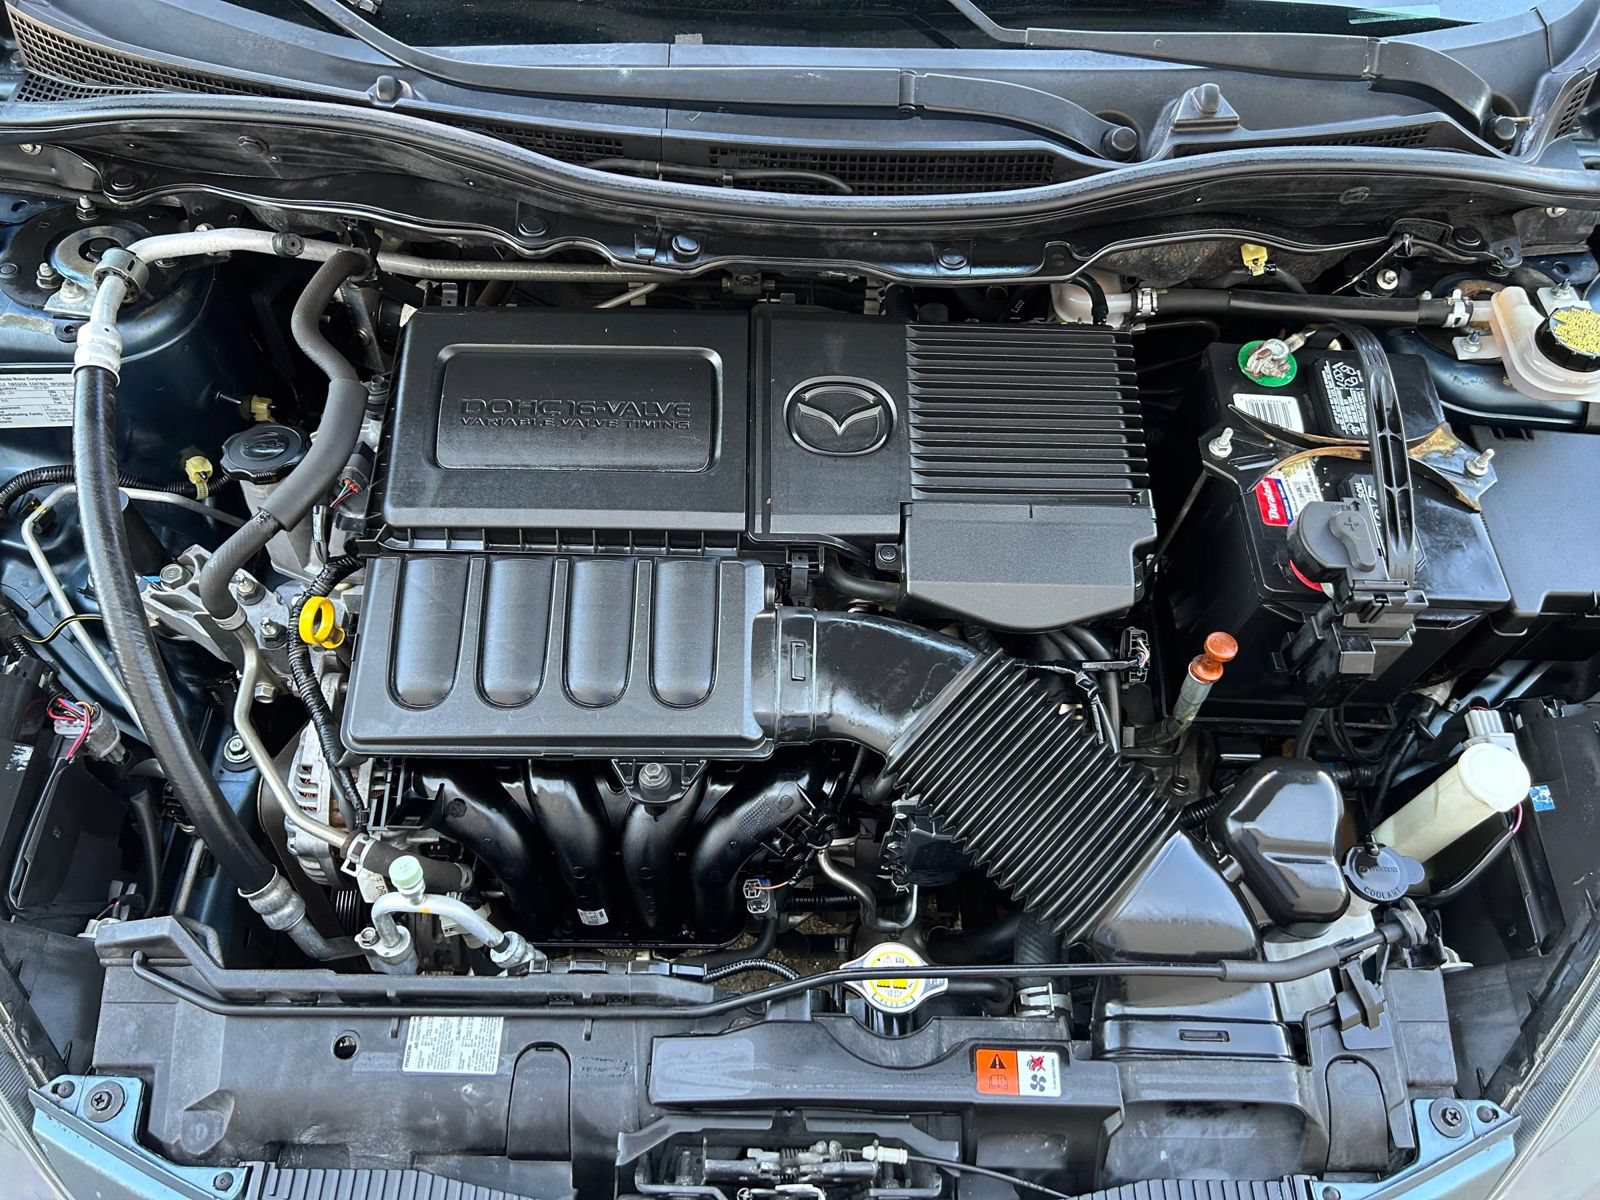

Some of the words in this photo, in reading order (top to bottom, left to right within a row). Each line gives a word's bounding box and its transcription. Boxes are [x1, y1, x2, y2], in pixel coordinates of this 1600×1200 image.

[460, 398, 562, 417] DOHC
[567, 399, 691, 418] 16-VALVE
[459, 416, 555, 428] VARIABLE
[559, 417, 619, 429] VALVE
[622, 419, 690, 430] TIMING
[1261, 478, 1280, 520] Duralast
[1330, 504, 1352, 512] OPEN
[1364, 886, 1401, 900] COOLANT
